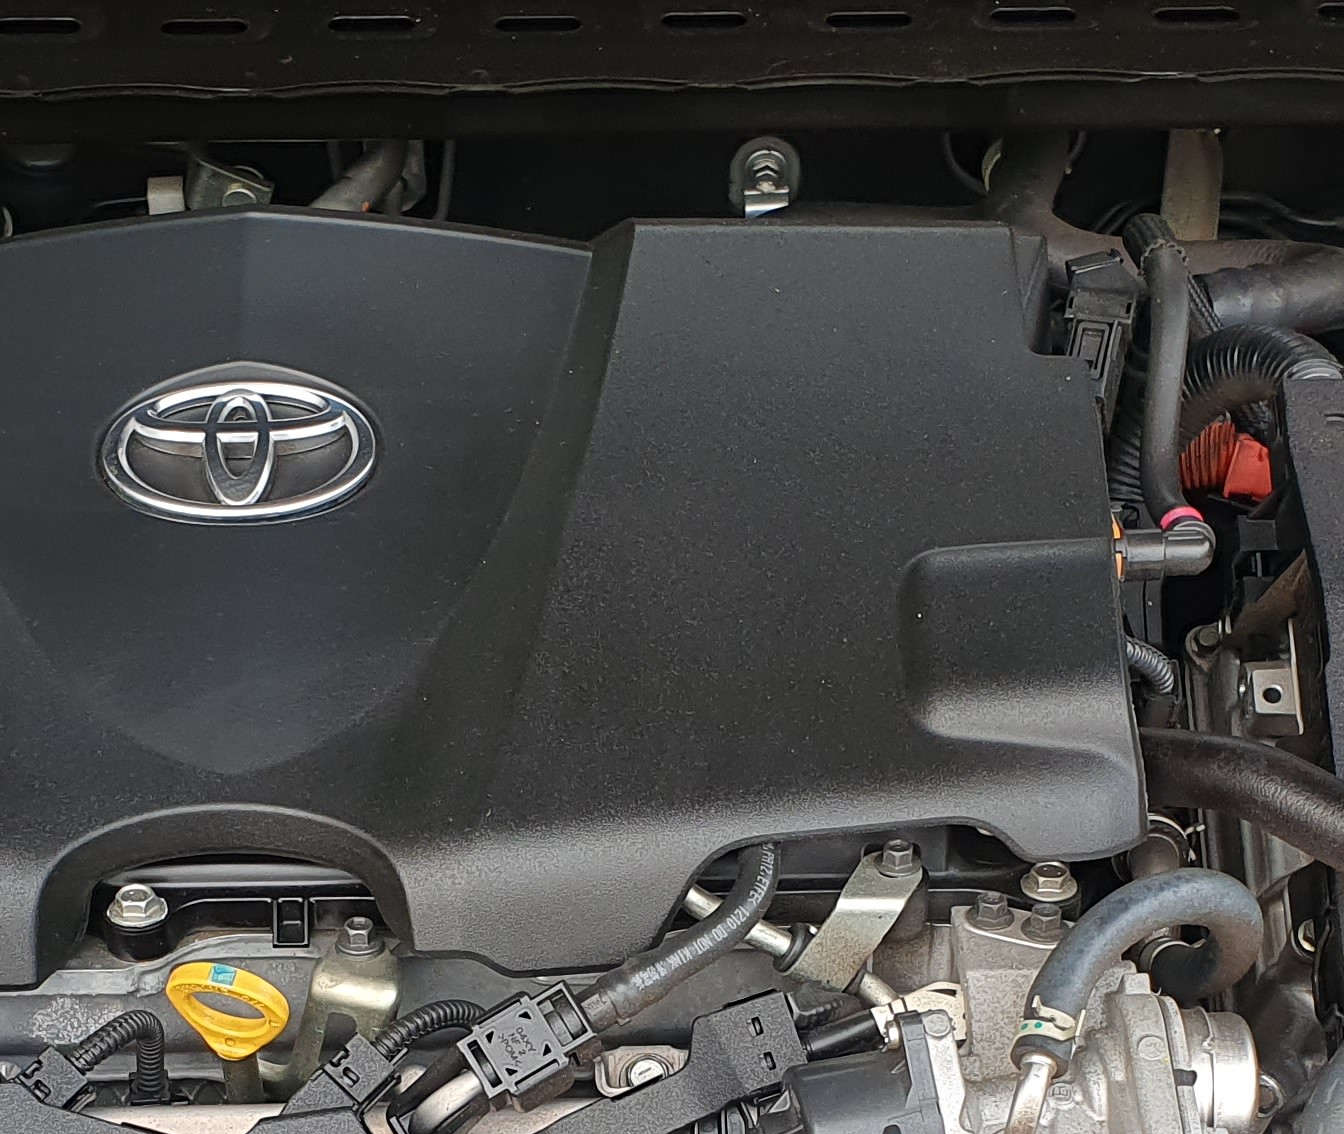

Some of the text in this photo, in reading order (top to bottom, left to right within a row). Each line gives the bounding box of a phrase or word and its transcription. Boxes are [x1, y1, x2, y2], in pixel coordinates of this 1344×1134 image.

[712, 924, 729, 941] DO
[692, 934, 713, 955] NOT
[666, 946, 693, 969] KINK
